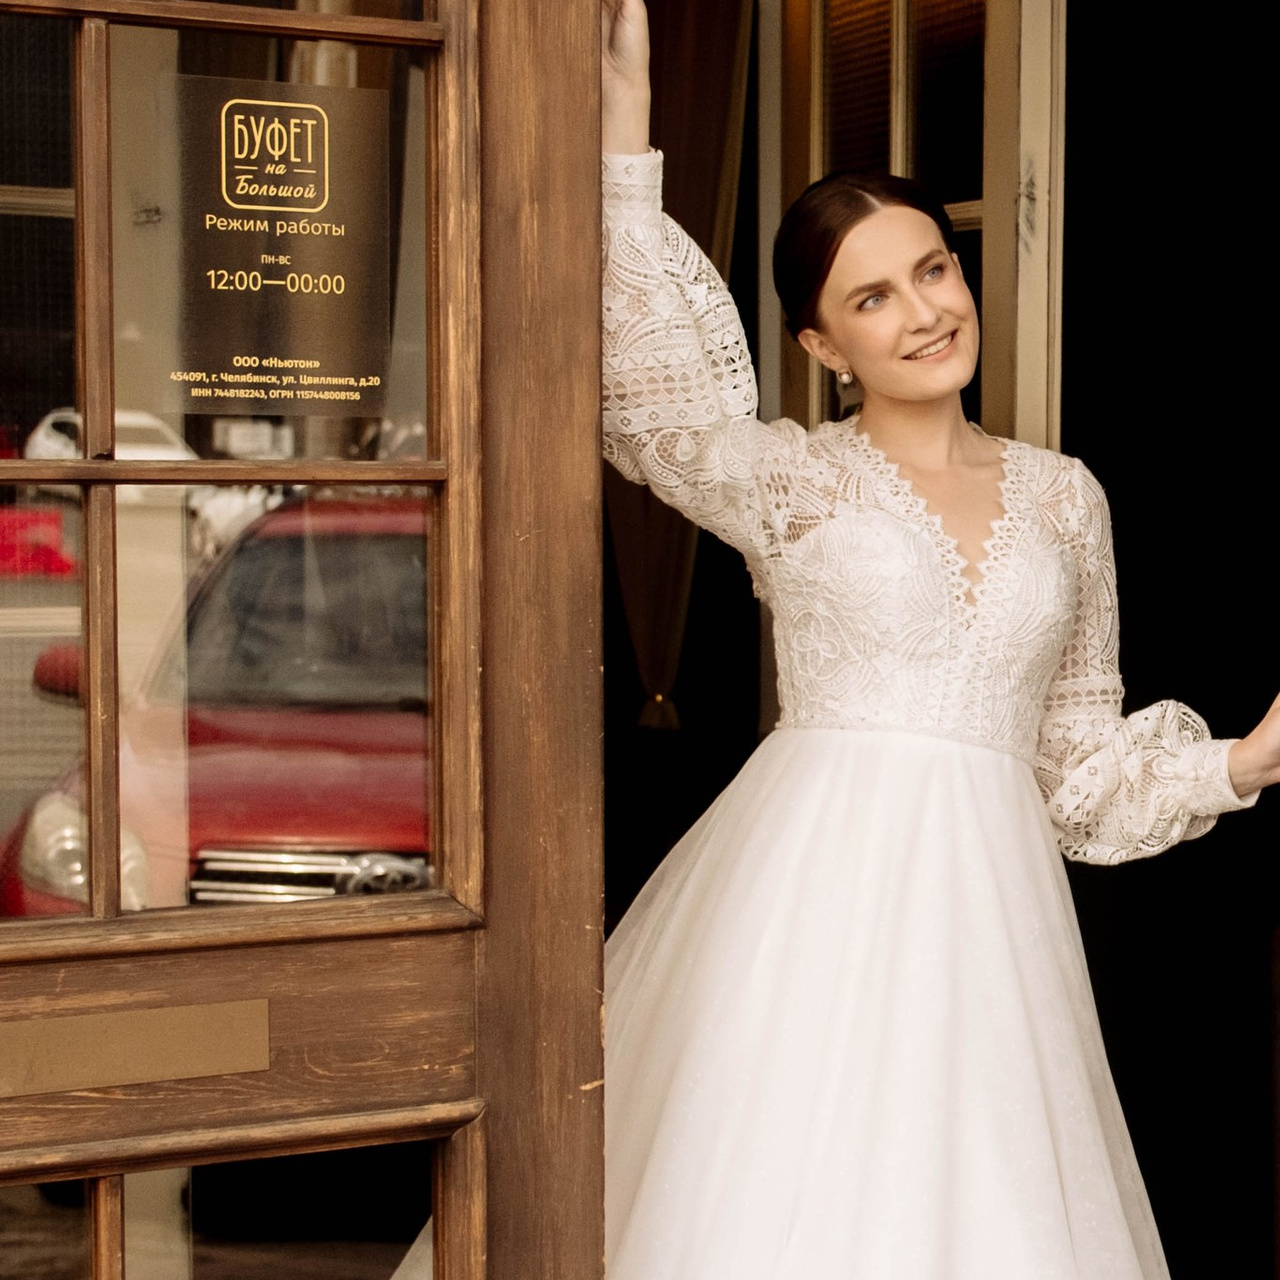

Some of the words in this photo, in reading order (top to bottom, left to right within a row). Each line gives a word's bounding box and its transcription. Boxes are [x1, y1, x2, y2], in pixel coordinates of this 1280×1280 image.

[233, 114, 317, 163] БУФЕТ
[264, 163, 287, 175] на
[235, 175, 317, 198] Большой
[205, 213, 269, 233] Режим
[275, 219, 346, 237] работы
[232, 356, 260, 367] ООО
[261, 357, 321, 368] «Ньютон»
[170, 371, 210, 384] 454091,
[211, 374, 219, 382] г.
[220, 372, 281, 386] Челябинск,
[282, 375, 298, 386] ул.
[299, 374, 358, 387] Цвиллинга,
[191, 387, 212, 397] ИНН
[268, 389, 294, 399] ОГРН
